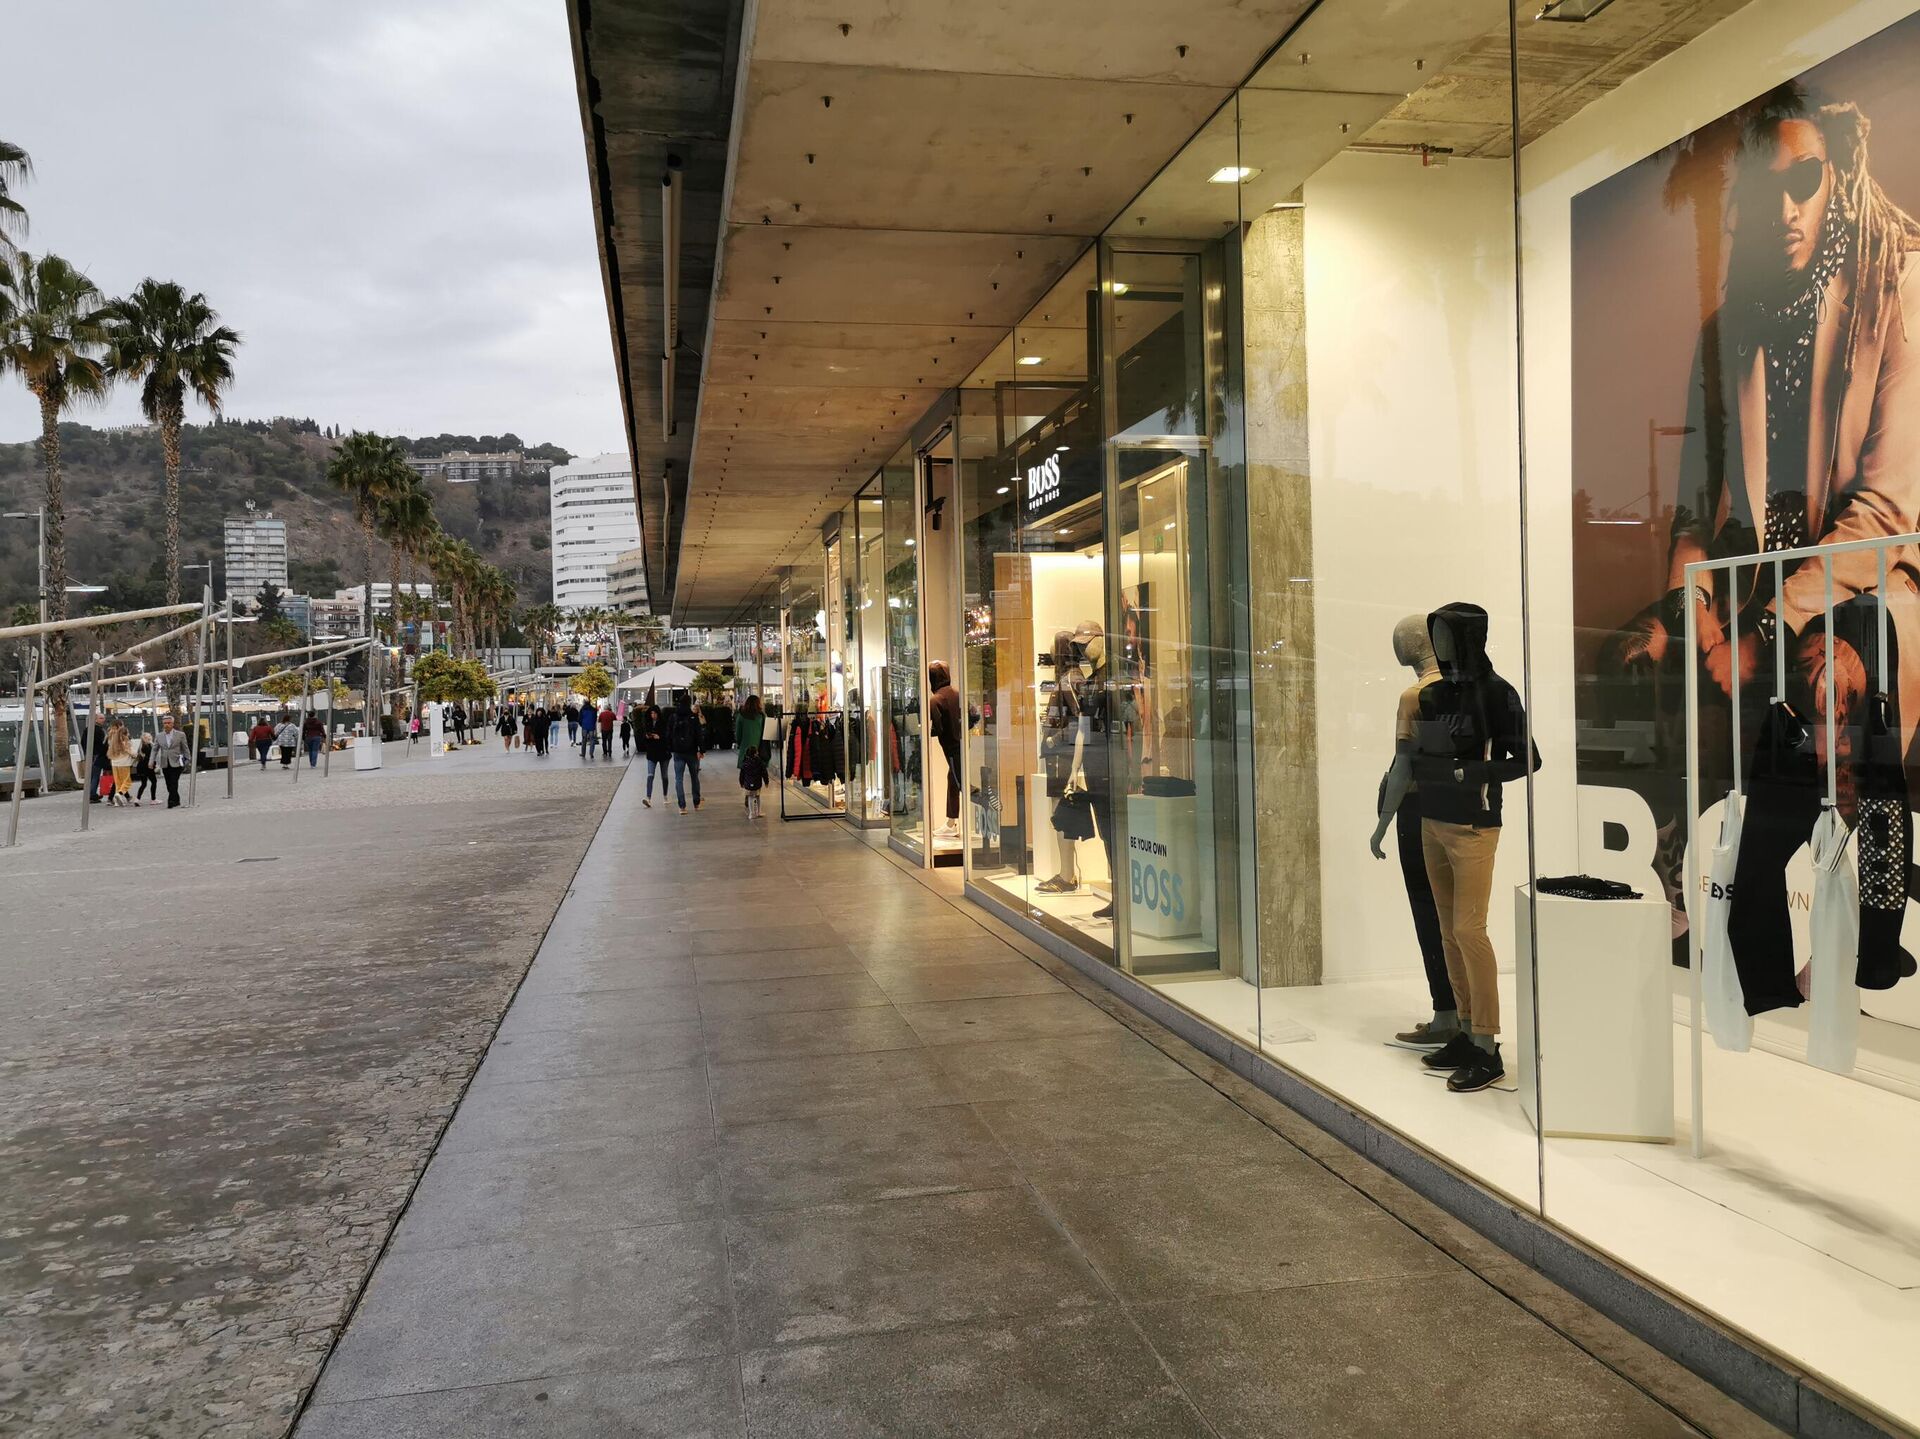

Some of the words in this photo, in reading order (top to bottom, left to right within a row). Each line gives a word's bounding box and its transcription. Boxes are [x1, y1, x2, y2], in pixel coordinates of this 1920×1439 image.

[1028, 453, 1060, 500] BOSS
[1130, 836, 1138, 849] BE
[1137, 837, 1152, 854] YOUR
[1152, 842, 1168, 858] OWN
[1130, 859, 1185, 922] BOSS
